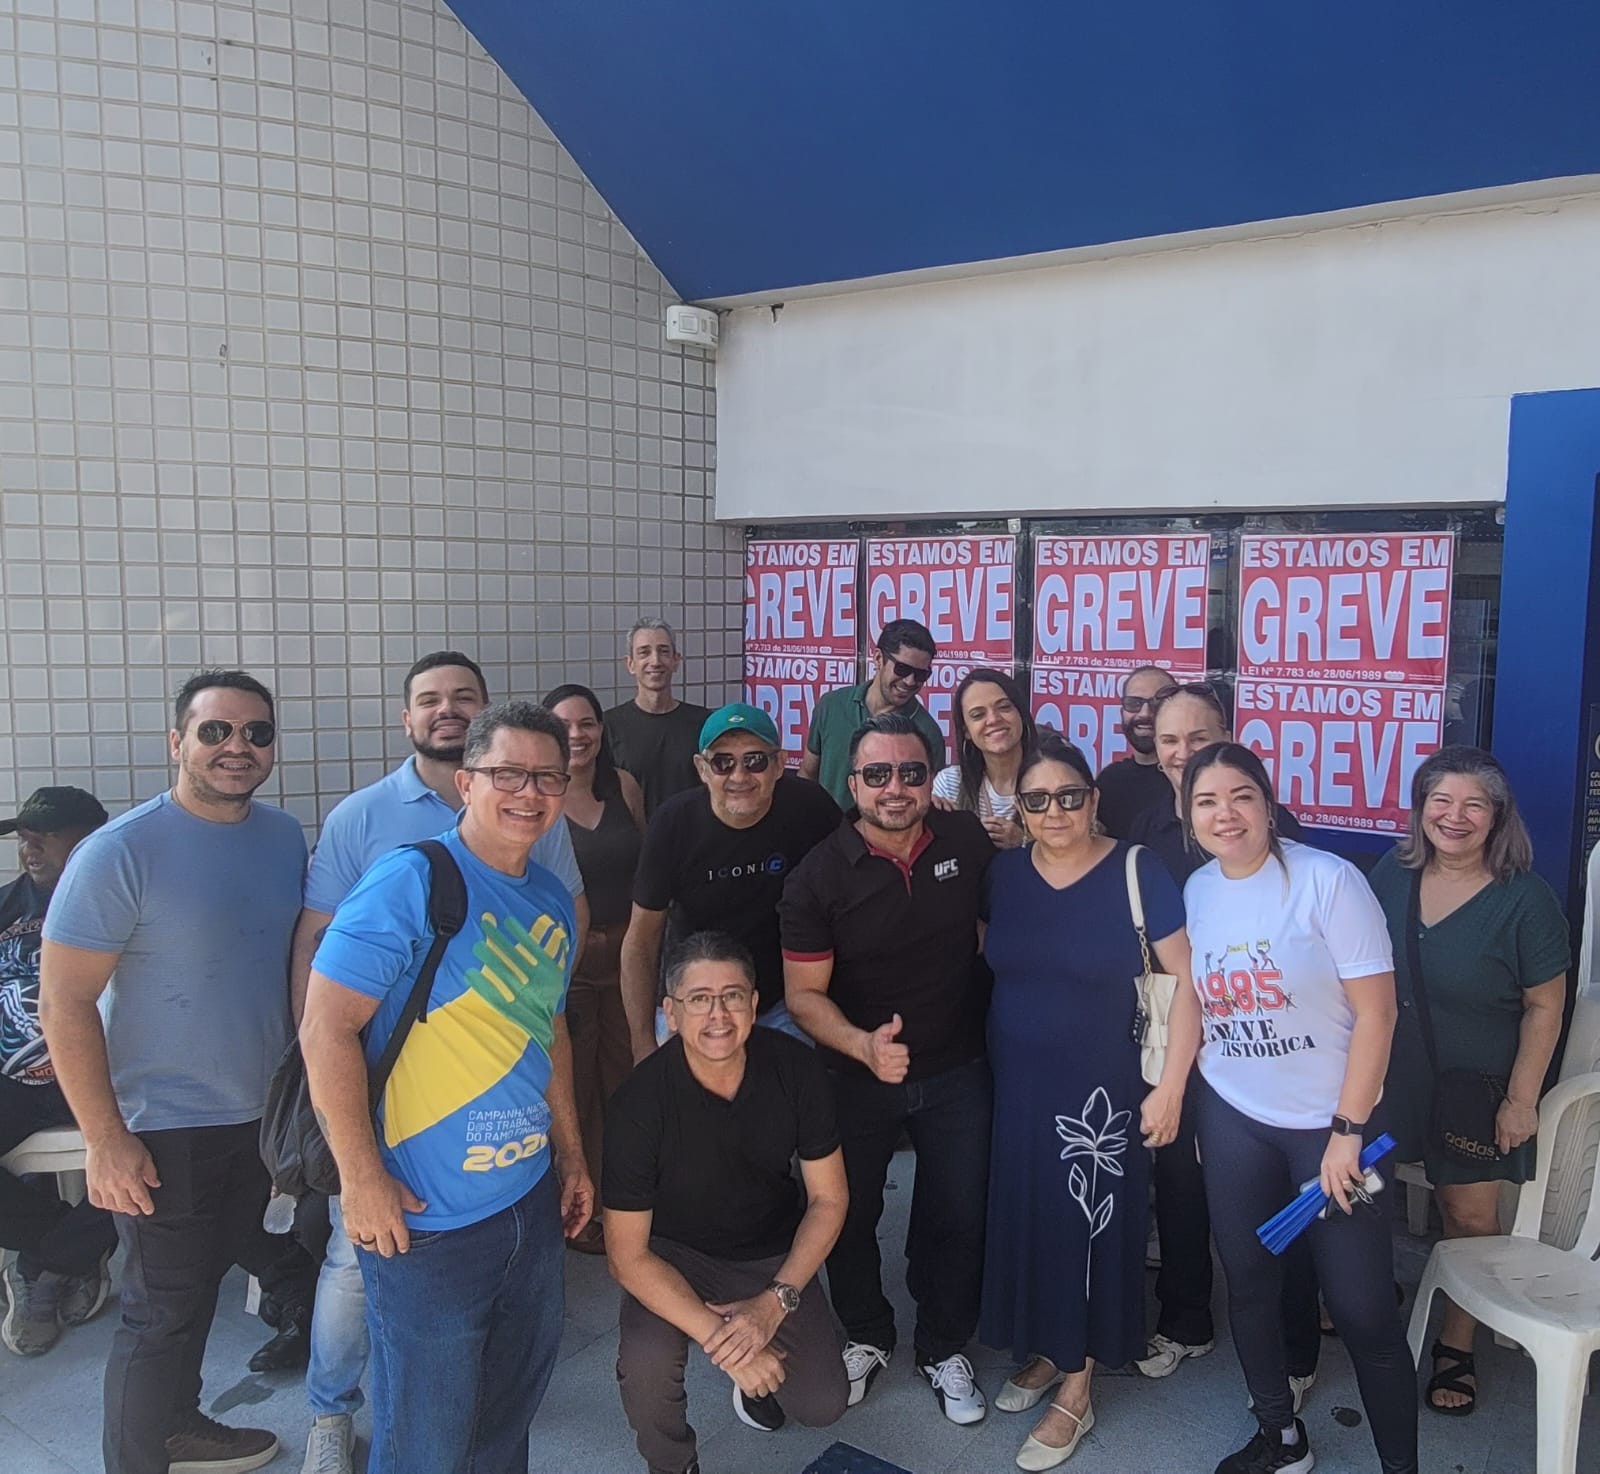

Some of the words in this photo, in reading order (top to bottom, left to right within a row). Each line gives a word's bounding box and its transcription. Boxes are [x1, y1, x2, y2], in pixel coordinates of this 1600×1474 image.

[747, 544, 821, 567] STAMOS
[827, 543, 856, 567] EM
[868, 540, 972, 567] ESTAMOS
[978, 540, 1013, 565] EM
[1037, 540, 1159, 566] ESTAMOS
[1167, 539, 1207, 566] EM
[1243, 538, 1390, 568] ESTAMOS
[1401, 538, 1449, 567] EM
[1036, 567, 1205, 654] GREVE
[1242, 568, 1447, 665] GREVE
[772, 644, 781, 652] de
[746, 656, 819, 681] STAMOS
[826, 661, 855, 683] EM
[1065, 656, 1089, 665] 7.783
[1091, 657, 1102, 666] de
[1241, 666, 1259, 675] LEI
[1276, 668, 1304, 678] 7.783
[1307, 668, 1320, 678] de
[1323, 669, 1382, 681] 28/06/1989
[1033, 671, 1126, 698] ESTAM
[1238, 684, 1382, 717] ESTAMOS
[1392, 690, 1441, 720] EM
[1300, 812, 1313, 821] de
[1315, 814, 1374, 828] 28/06/1989
[934, 858, 959, 877] UFC
[466, 1132, 482, 1142] DO
[1445, 1132, 1496, 1156] adidas
